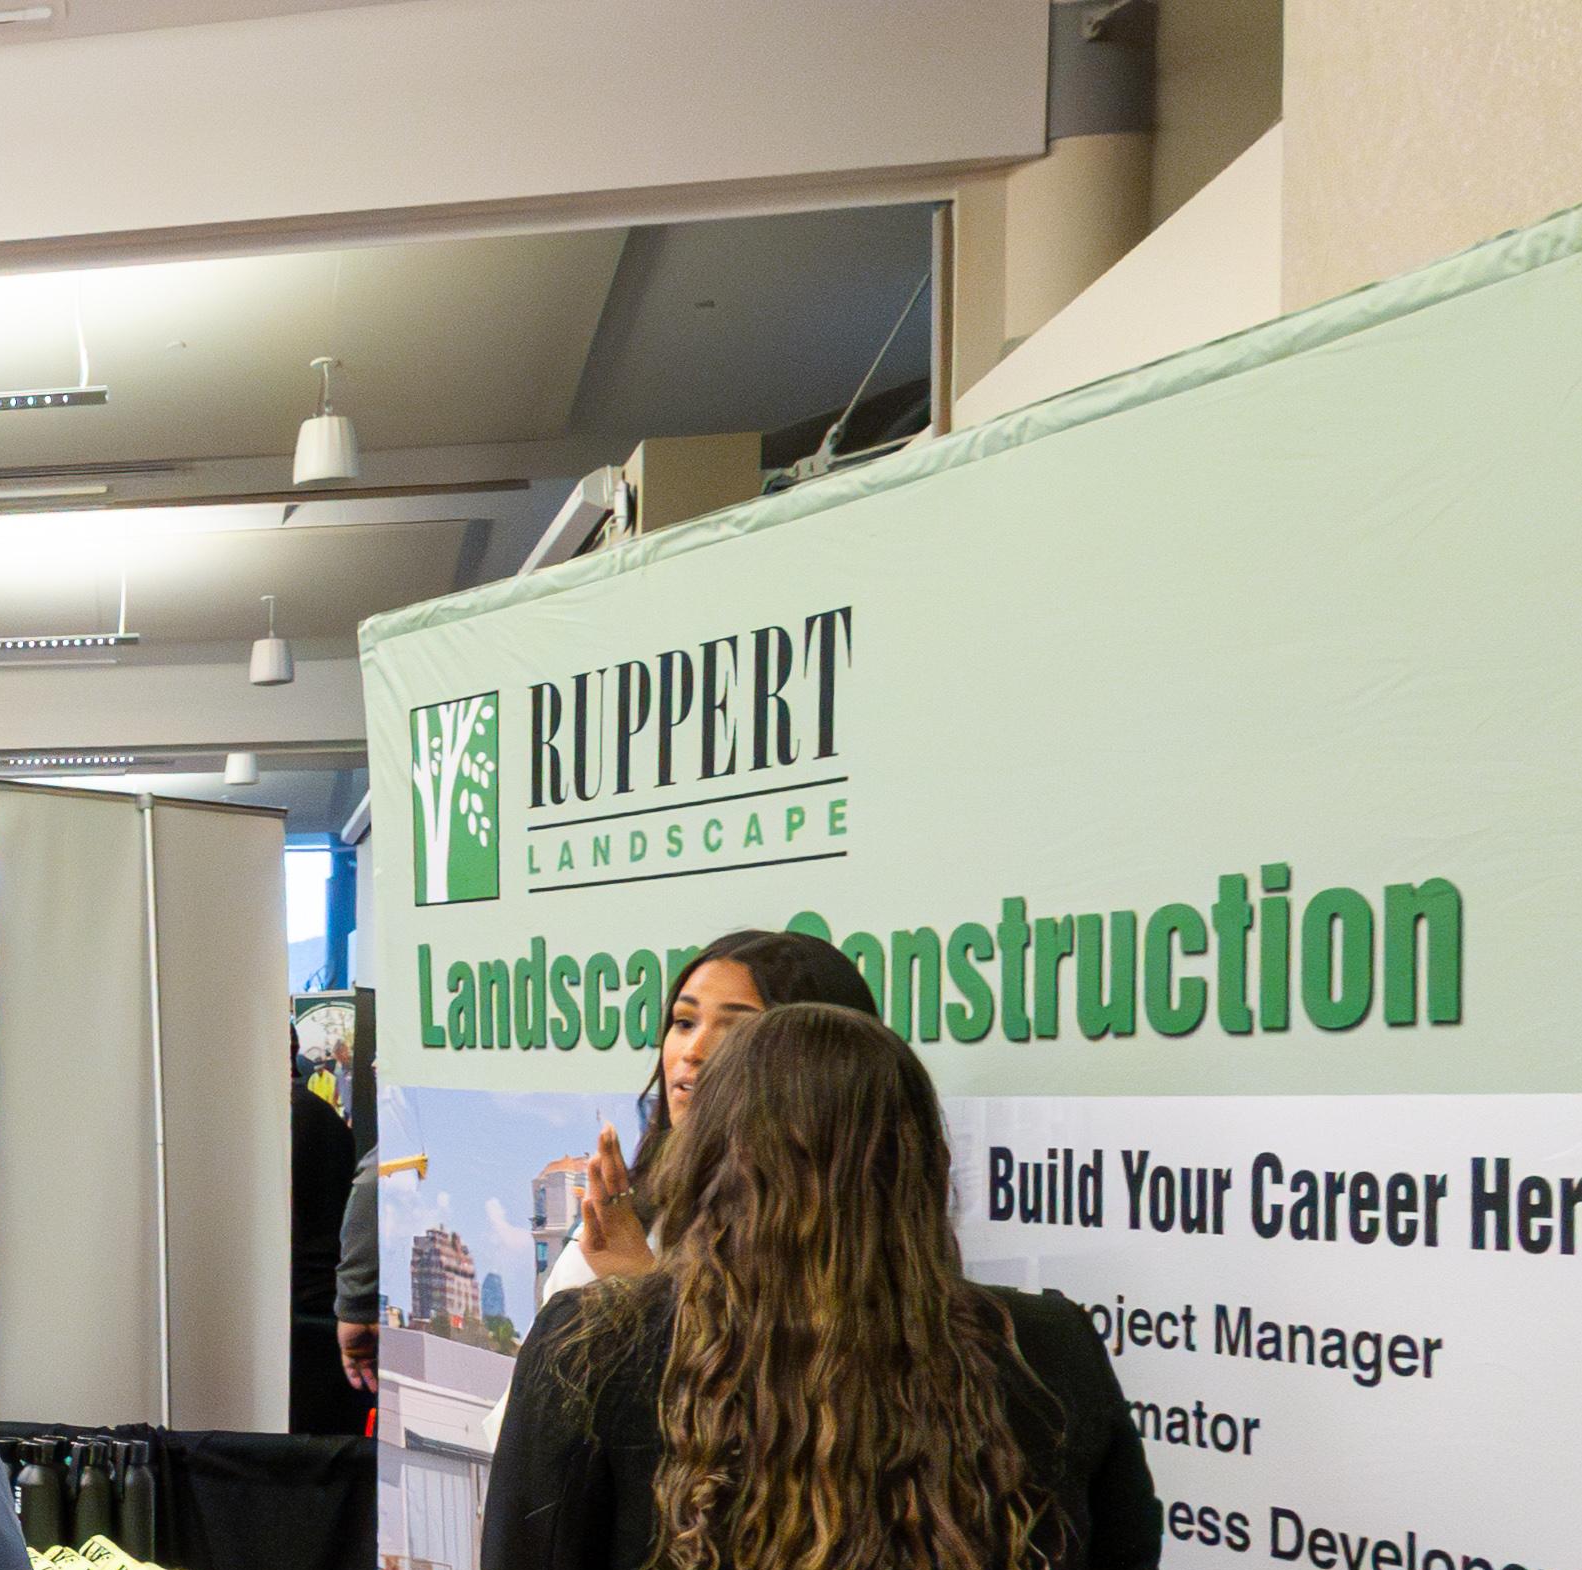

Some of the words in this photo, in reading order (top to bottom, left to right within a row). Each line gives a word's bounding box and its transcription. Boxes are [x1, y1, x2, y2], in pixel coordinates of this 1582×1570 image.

[527, 605, 852, 808] RUPPERT
[527, 799, 848, 875] LANDSCAPE
[418, 935, 703, 1050] Landsca
[989, 1146, 1103, 1228] Build
[1121, 1149, 1232, 1236] Your
[1250, 1152, 1448, 1248] Career
[1469, 1156, 1582, 1256] Her
[1086, 1295, 1197, 1358] oject
[1214, 1304, 1443, 1388] Manager
[1130, 1400, 1260, 1456] mator
[1168, 1501, 1251, 1552] ess
